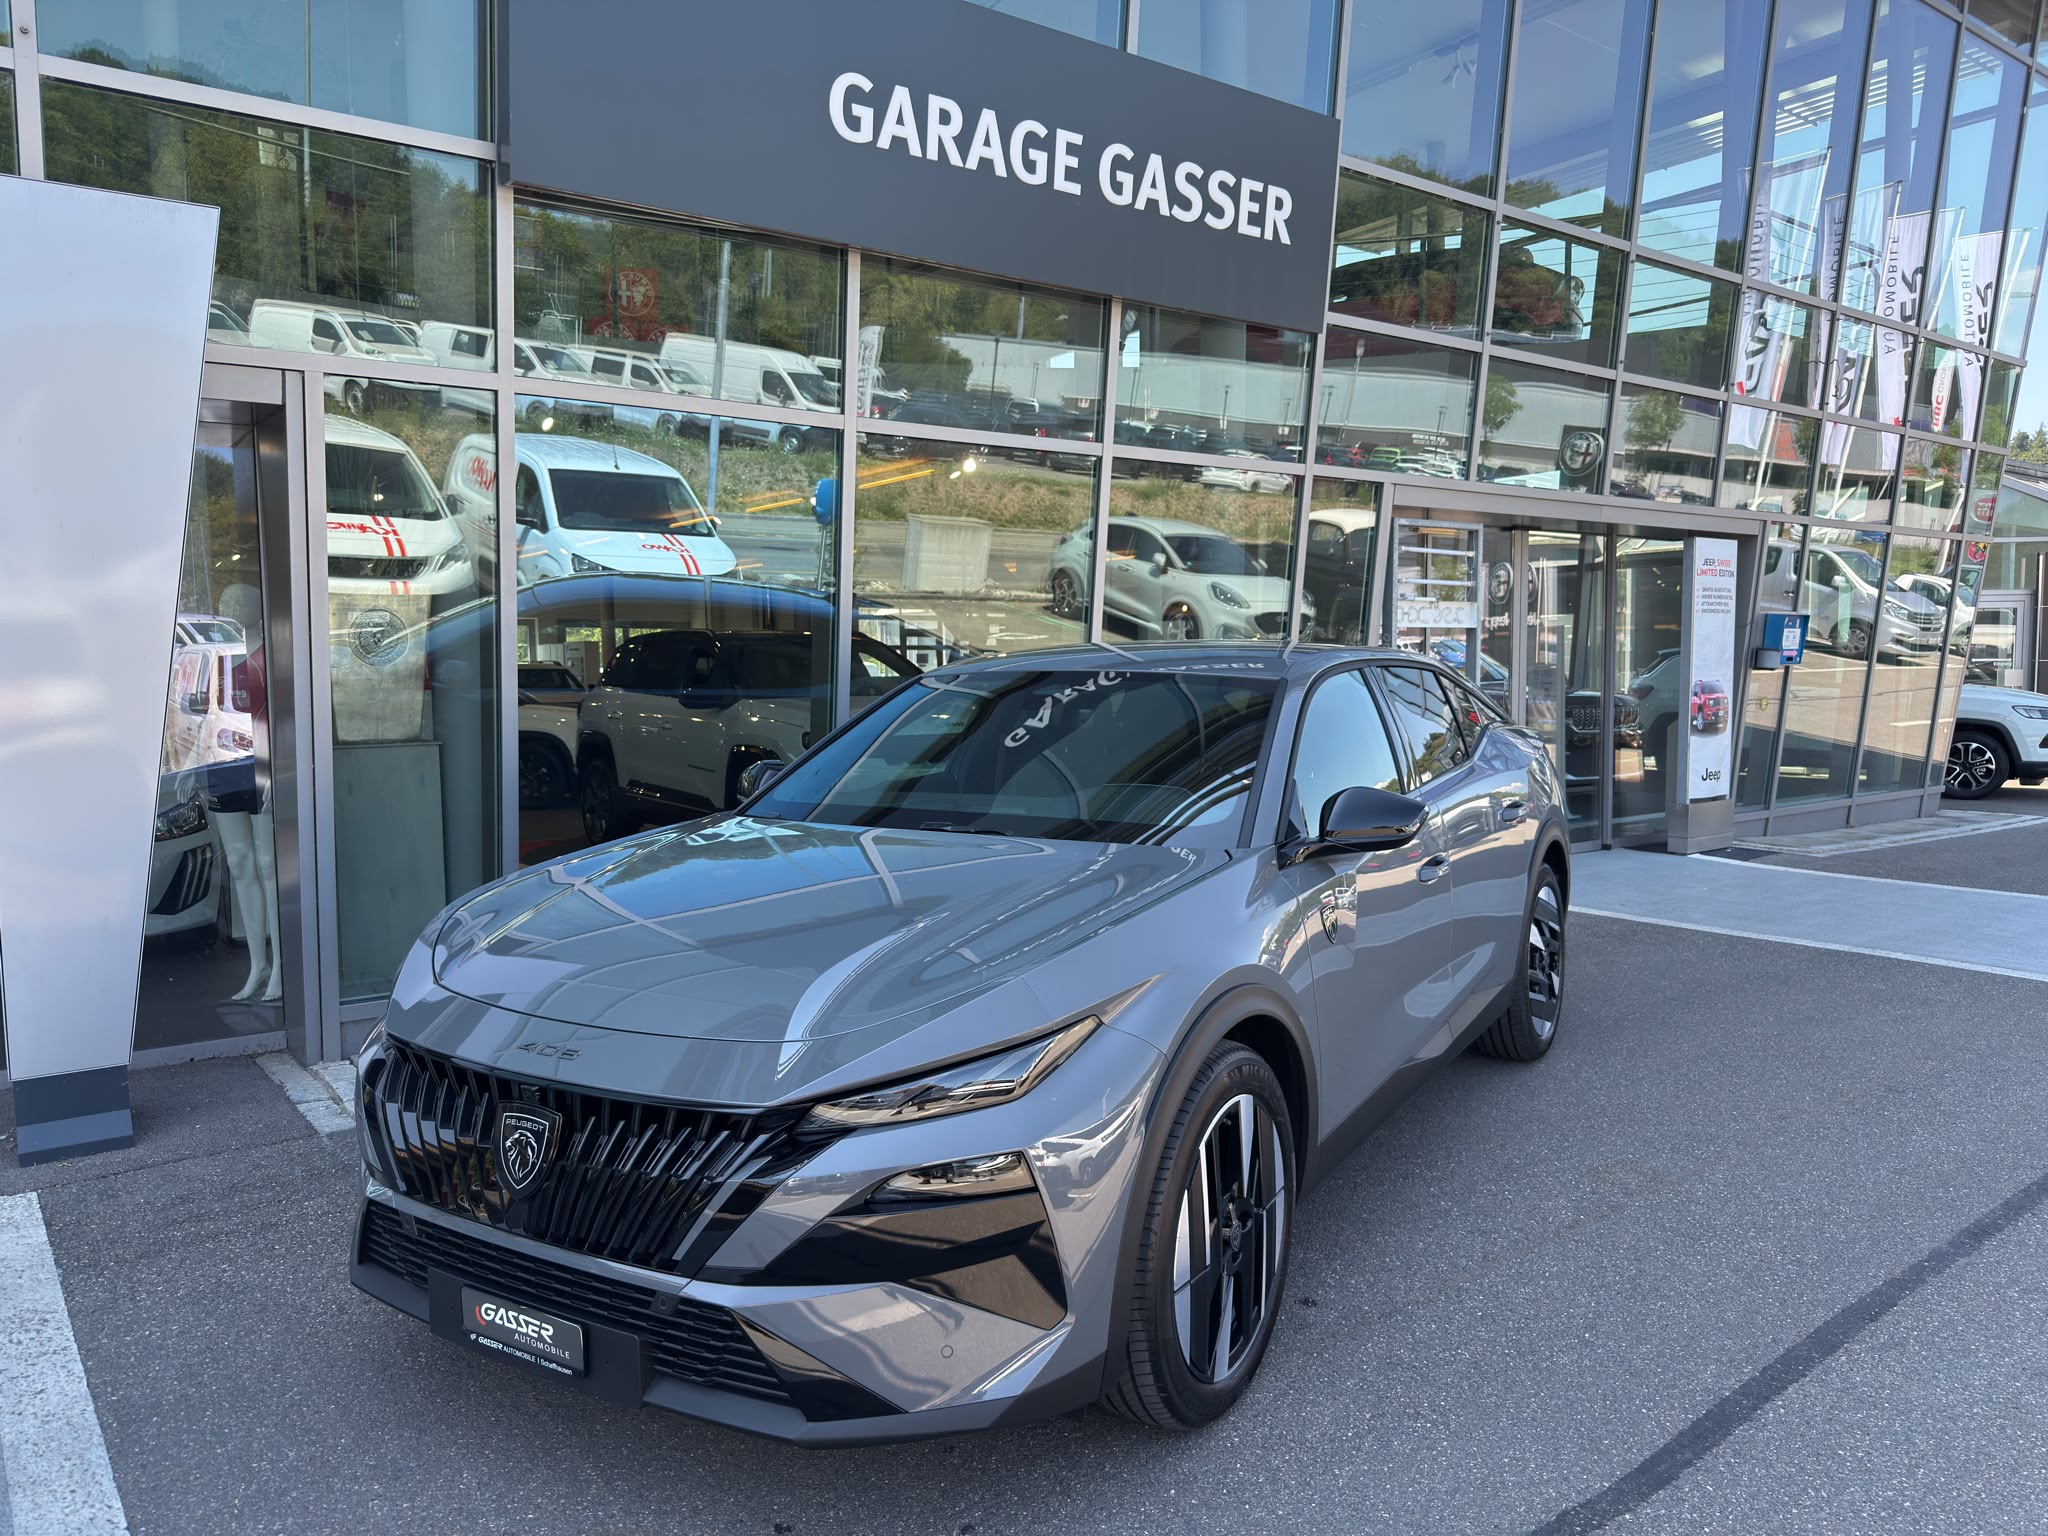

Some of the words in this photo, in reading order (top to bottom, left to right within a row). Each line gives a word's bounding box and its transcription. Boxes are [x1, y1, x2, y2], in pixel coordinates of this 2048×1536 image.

[829, 72, 1084, 196] GARAGE
[1098, 143, 1293, 245] GASSER
[1697, 568, 1719, 577] LIMITED
[1701, 767, 1721, 783] Jeep
[518, 1042, 583, 1061] 408
[505, 1118, 545, 1132] PEUGEOT
[480, 1302, 554, 1344] GASSER
[478, 1336, 503, 1351] GASSER
[503, 1345, 537, 1363] AUTOMOBILE
[540, 1358, 573, 1376] Schaffhausen
[514, 1332, 571, 1360] AUTOMOBILE
